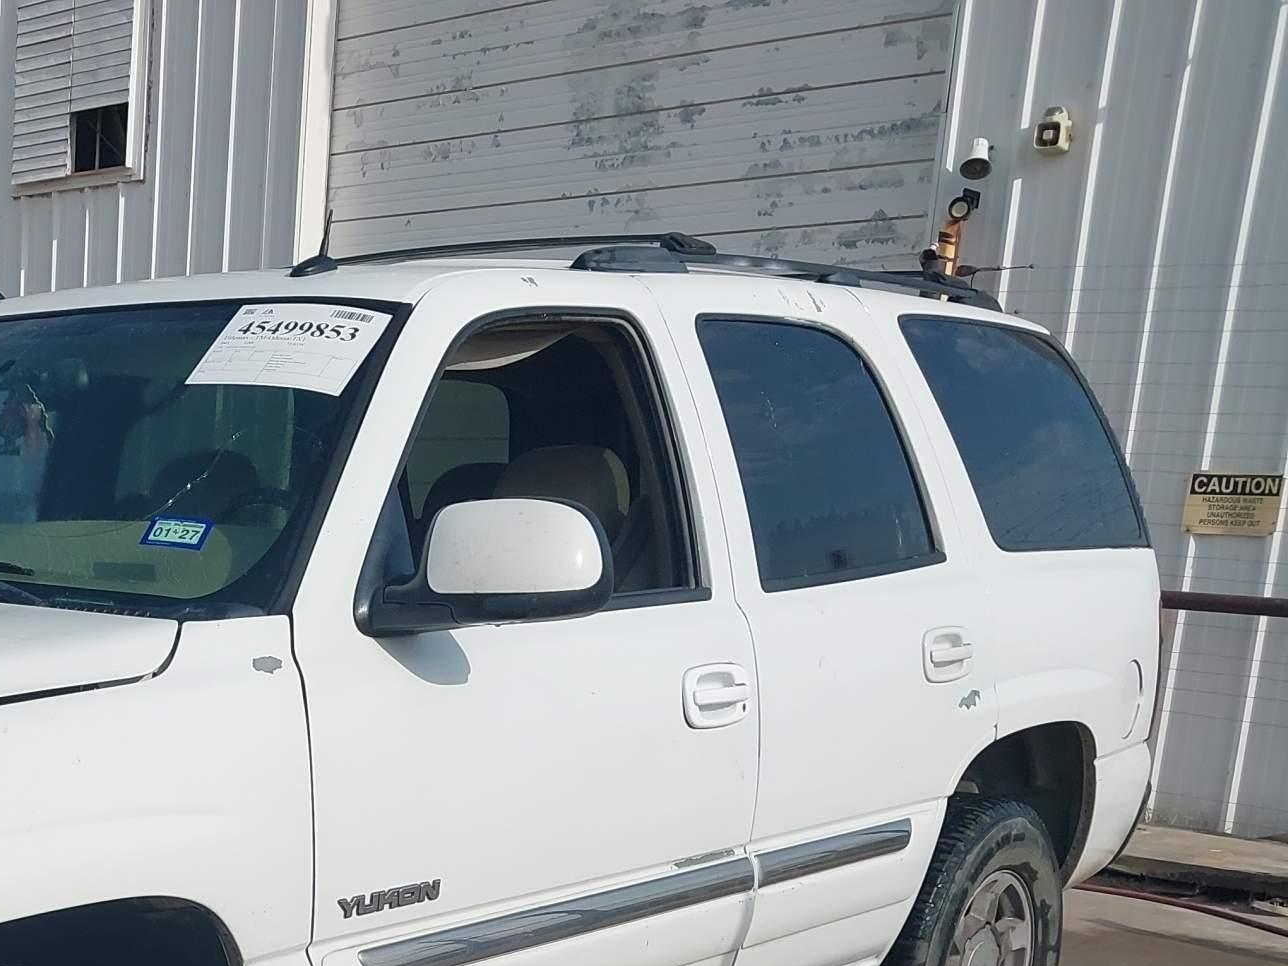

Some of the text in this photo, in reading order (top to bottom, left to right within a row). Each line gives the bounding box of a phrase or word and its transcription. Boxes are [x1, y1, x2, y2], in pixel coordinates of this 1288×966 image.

[238, 320, 360, 342] 45499853
[1194, 477, 1279, 494] CAUTION
[1198, 518, 1229, 526] PERSONS
[337, 879, 441, 919] YUKON
